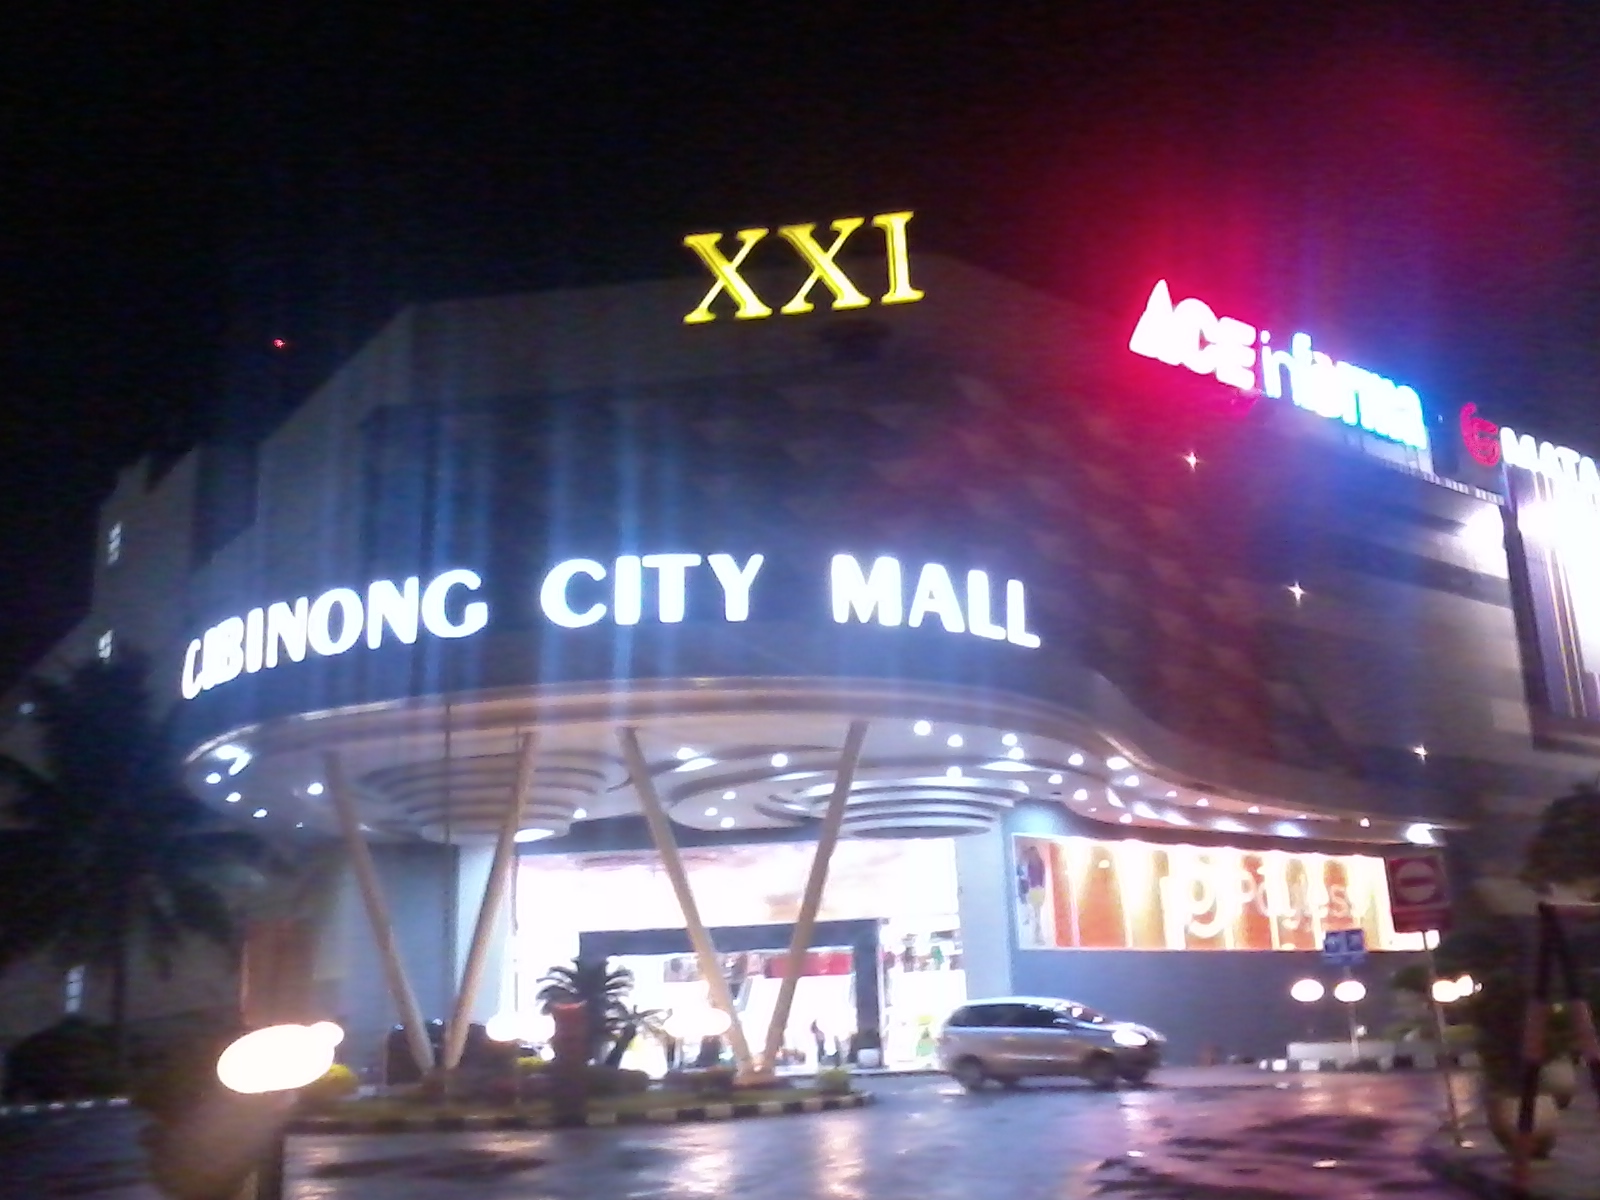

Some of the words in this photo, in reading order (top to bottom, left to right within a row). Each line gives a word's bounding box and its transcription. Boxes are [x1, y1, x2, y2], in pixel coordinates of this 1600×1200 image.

[683, 211, 925, 324] XXI
[1129, 279, 1256, 390] ACE
[181, 569, 488, 699] CIBINONG
[540, 553, 764, 628] CITY
[830, 553, 1041, 648] MALL
